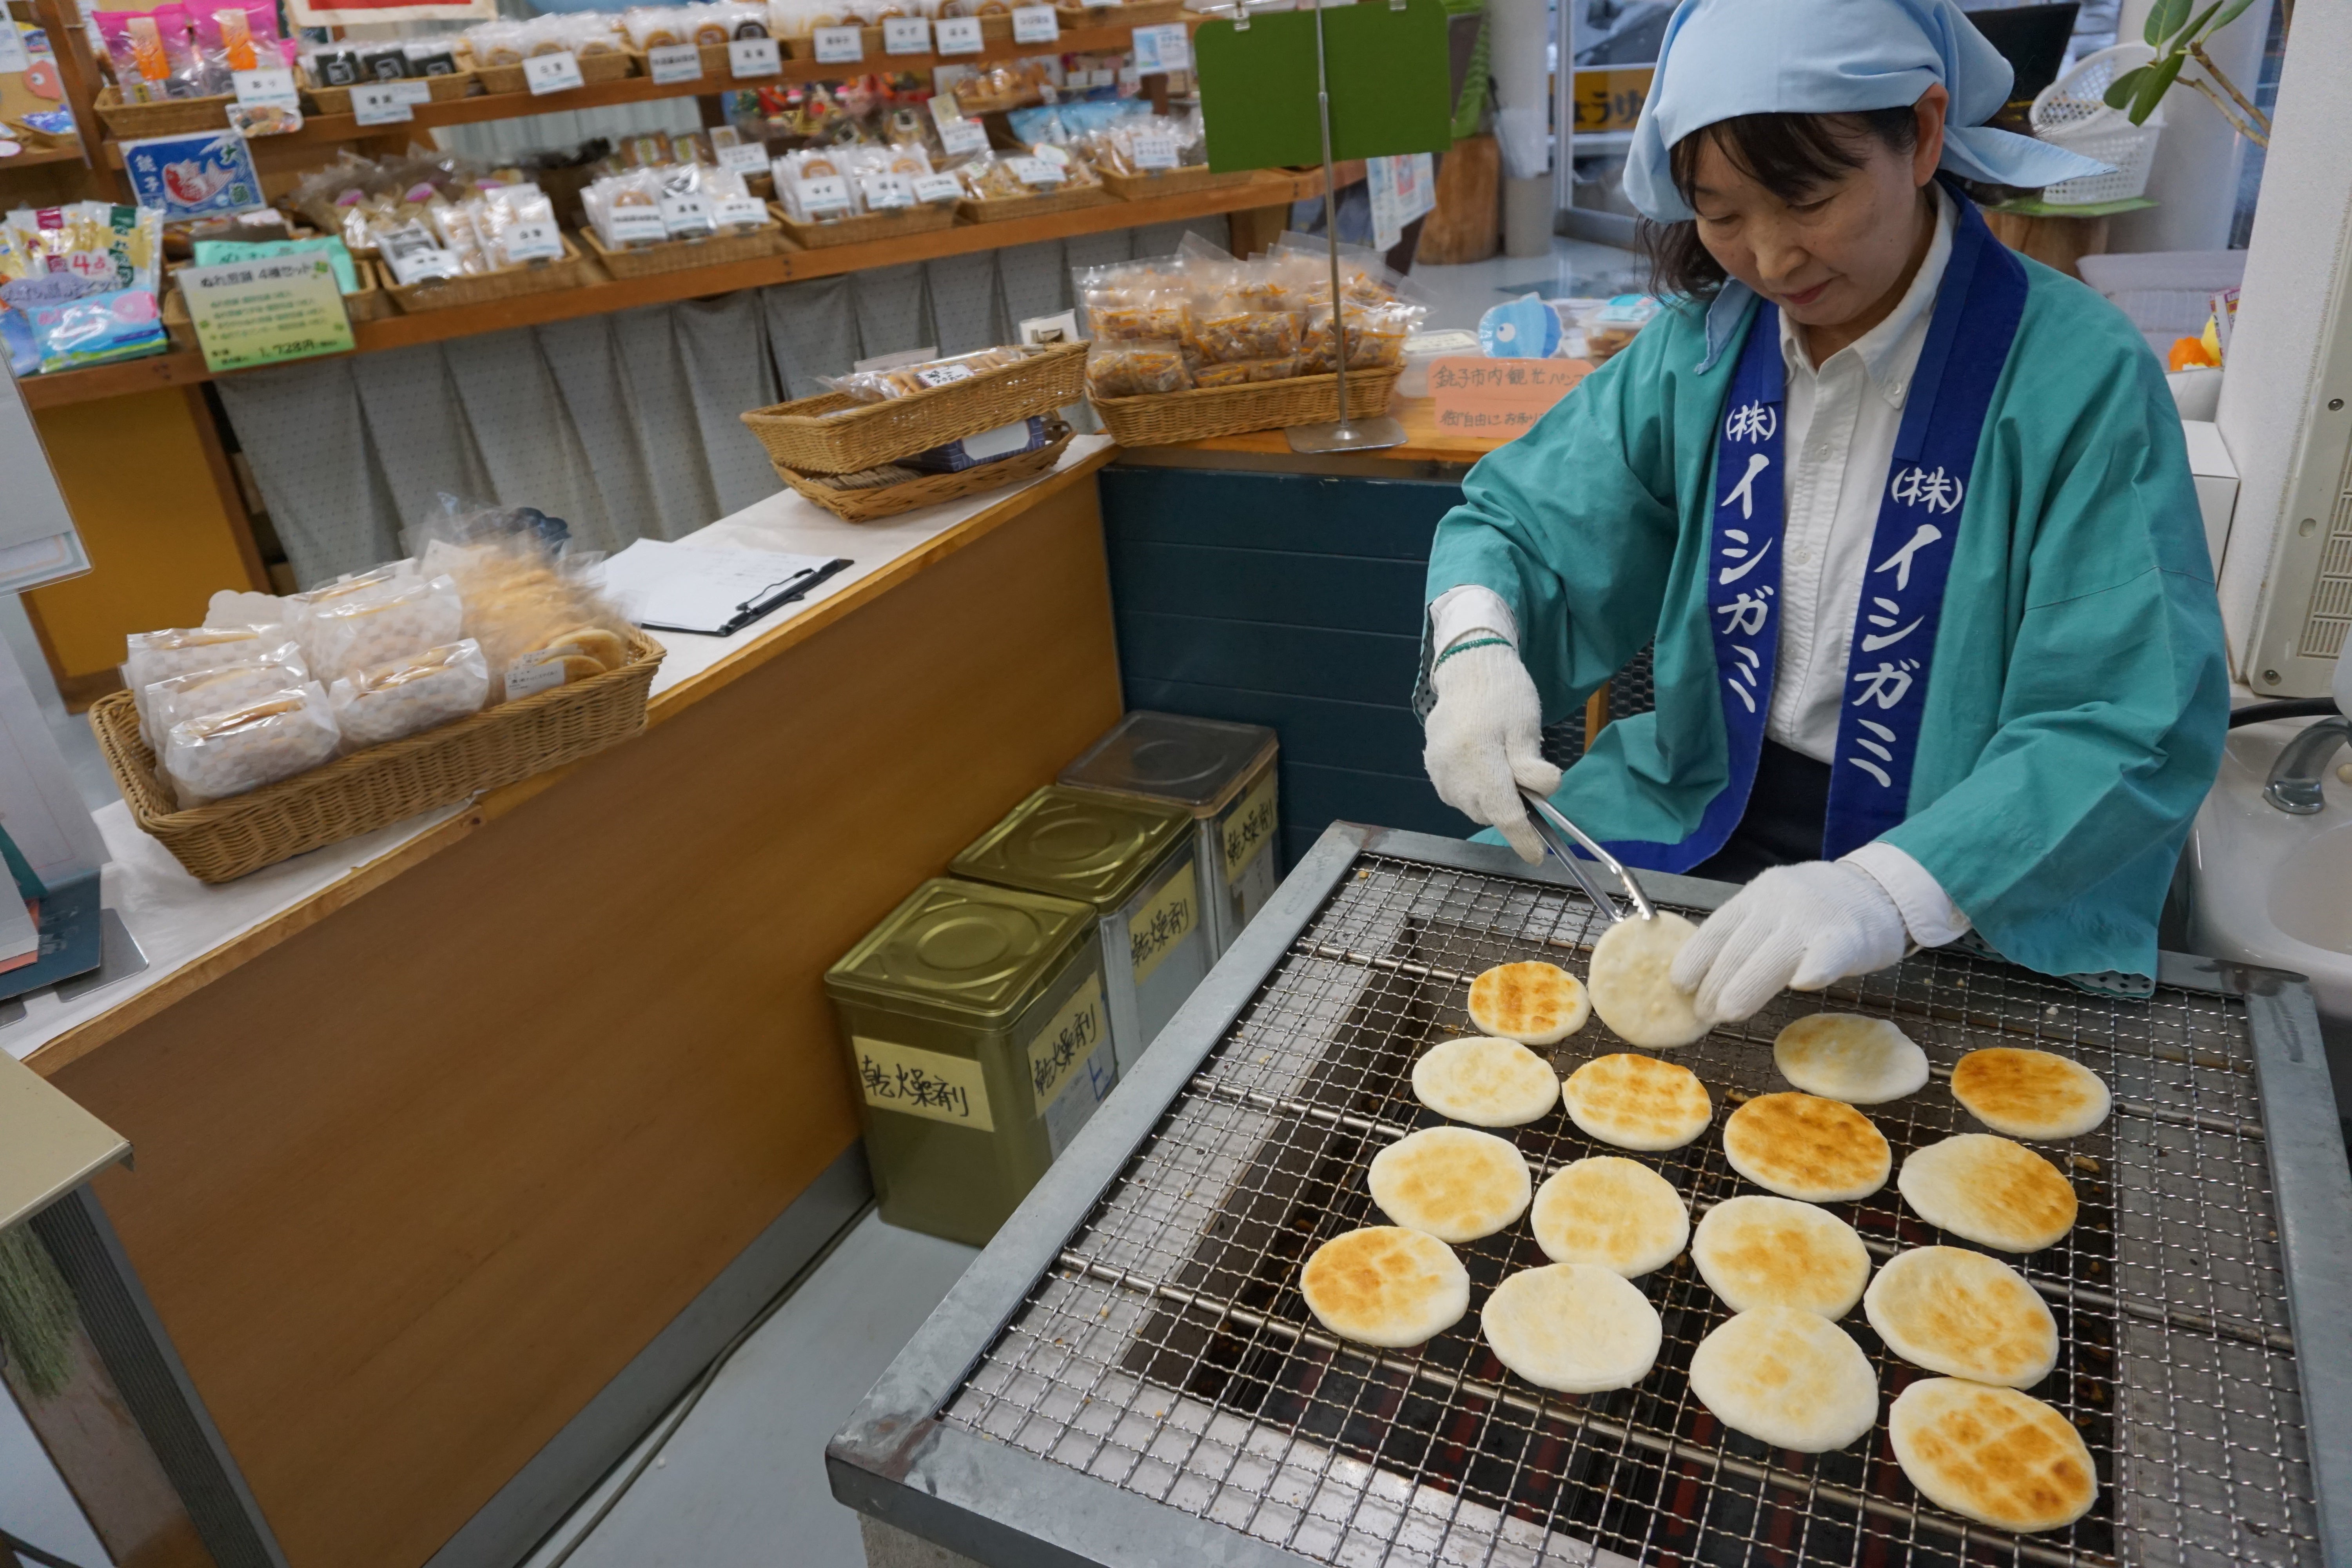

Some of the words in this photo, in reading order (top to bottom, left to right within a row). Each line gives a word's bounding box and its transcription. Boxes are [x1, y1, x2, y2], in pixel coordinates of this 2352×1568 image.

[1439, 409, 1544, 427] 御自由にお取り
[1718, 399, 1776, 714] (株)イシガミ
[1848, 466, 1963, 788] (株)イシガミ
[1131, 898, 1189, 968] 乾燥剤
[860, 1054, 969, 1117] 乾燥剤
[1034, 1003, 1096, 1097] 乾燥剤
